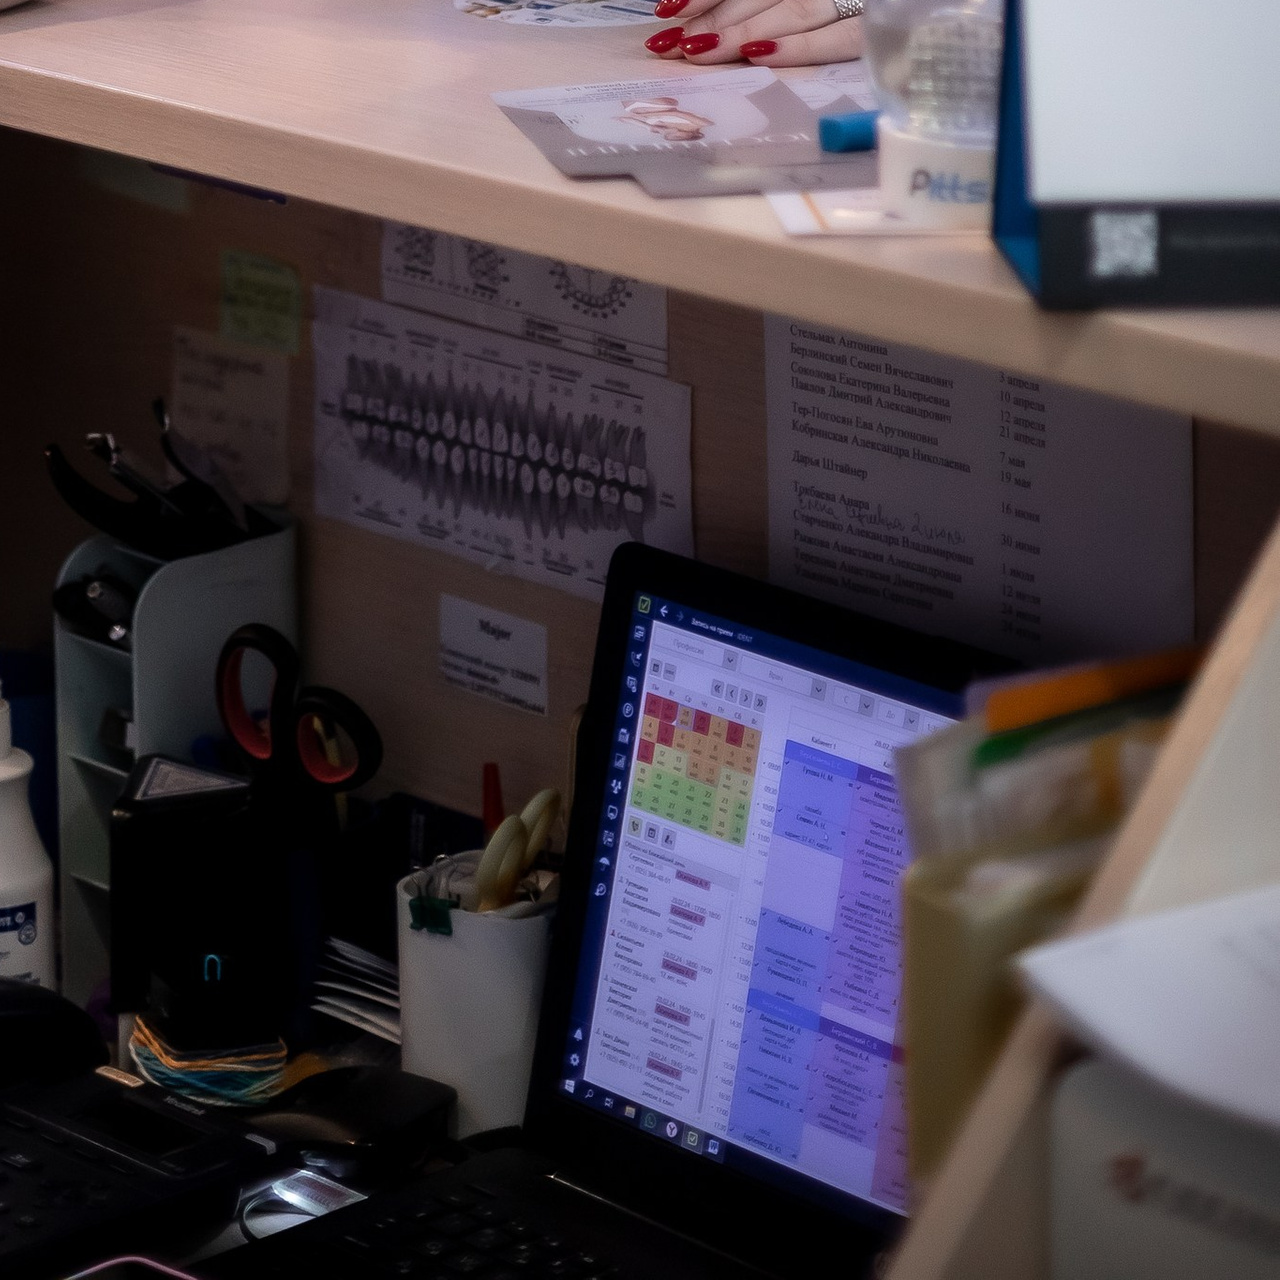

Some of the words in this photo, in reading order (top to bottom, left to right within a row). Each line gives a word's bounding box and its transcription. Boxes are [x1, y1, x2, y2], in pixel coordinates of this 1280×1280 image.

[850, 355, 881, 374] Семен
[884, 362, 953, 390] Вячеславович
[790, 360, 836, 383] Соколова
[839, 371, 890, 397] Екатерина
[893, 384, 950, 410] Валерьевна
[1000, 390, 1010, 403] 10
[828, 384, 872, 408] Дмитрий
[875, 395, 951, 426] Александрович
[855, 416, 873, 430] Ева
[1000, 409, 1010, 423] 12
[999, 425, 1009, 438] 21
[852, 434, 910, 461] Александра
[912, 448, 971, 474] Николаевна
[999, 451, 1005, 463] 7
[822, 457, 867, 481] Штайнер
[1000, 470, 1011, 484] 19
[1013, 476, 1031, 489] мая
[1001, 502, 1012, 516] 16
[1000, 534, 1012, 548] 30
